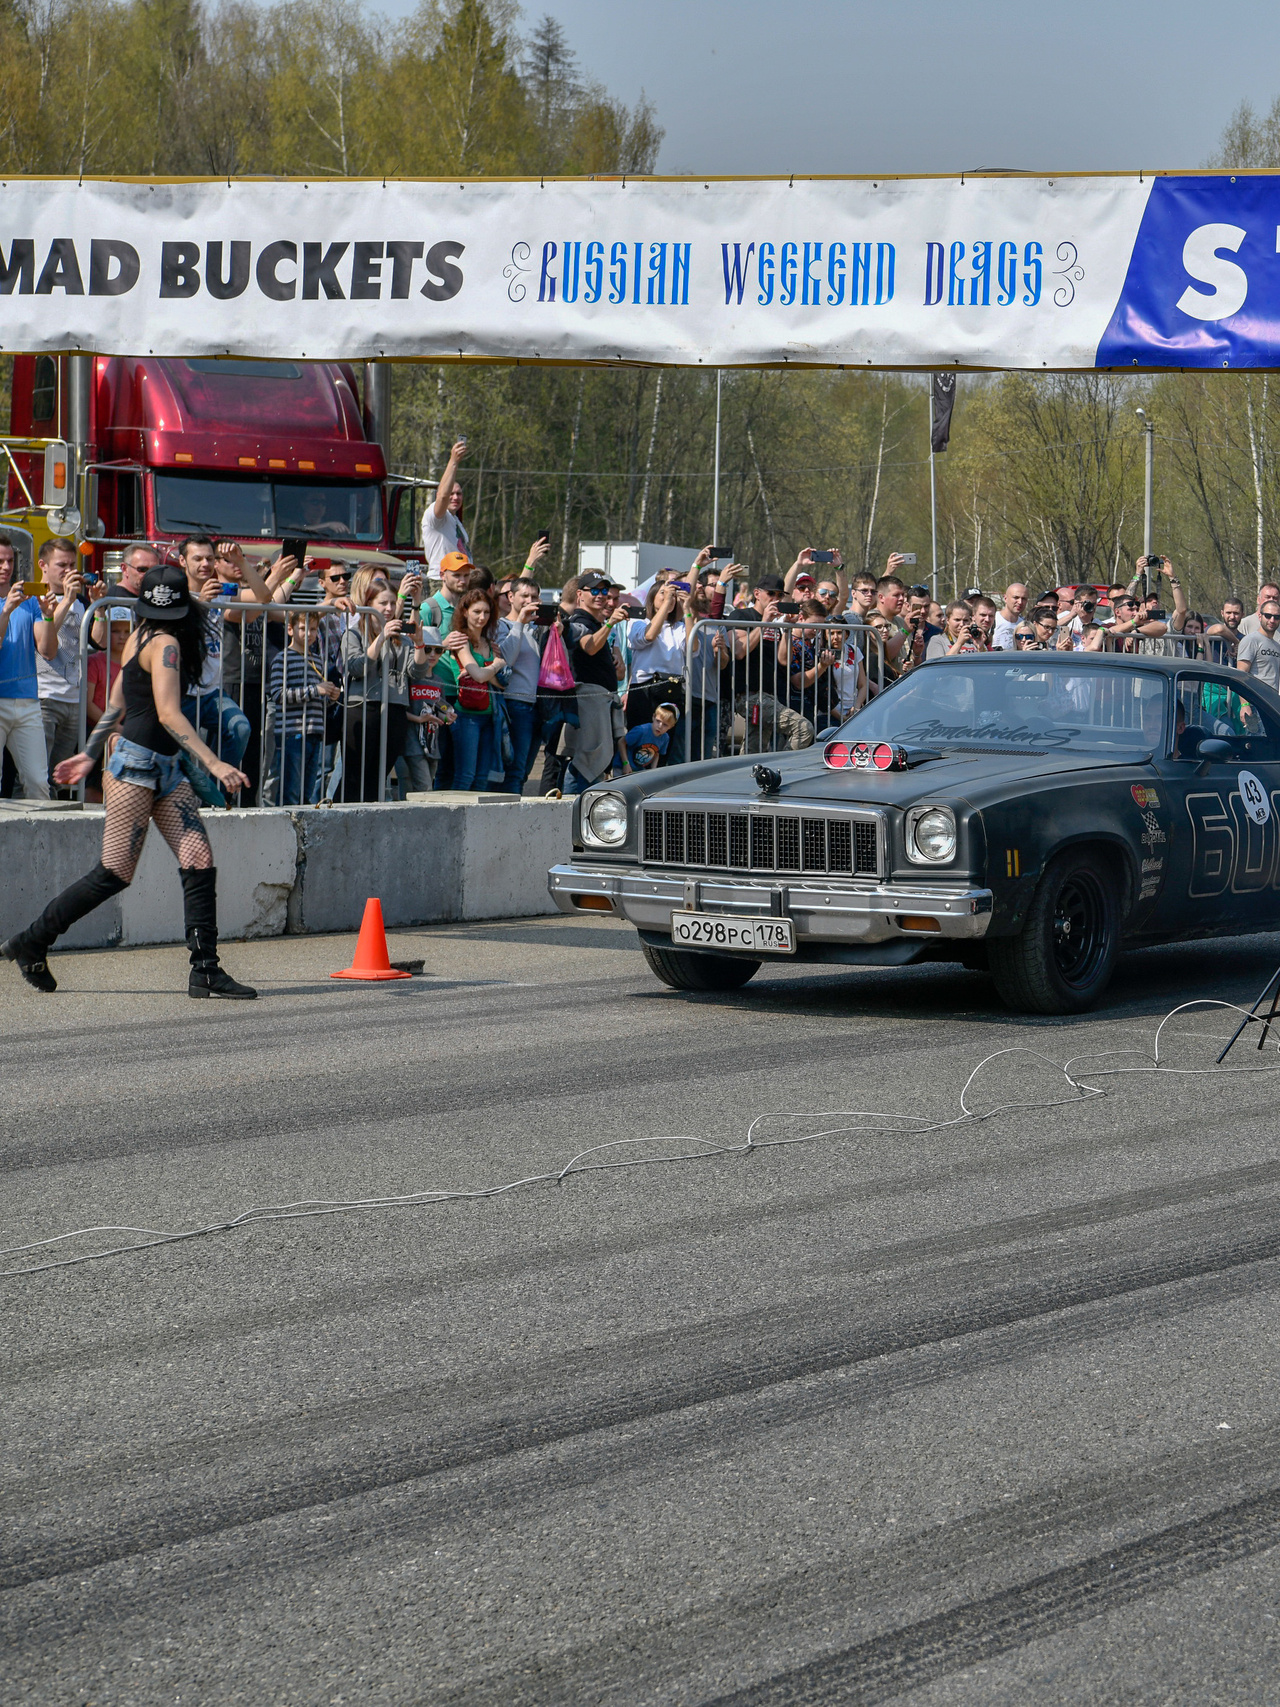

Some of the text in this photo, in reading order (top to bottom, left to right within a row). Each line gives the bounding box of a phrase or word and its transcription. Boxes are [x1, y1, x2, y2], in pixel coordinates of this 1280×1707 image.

[0, 239, 465, 301] MAD BUCKETS
[539, 241, 1043, 306] RUSSIAN WEEKEND DRAGS
[1244, 779, 1262, 805] 43
[756, 925, 784, 941] 178
